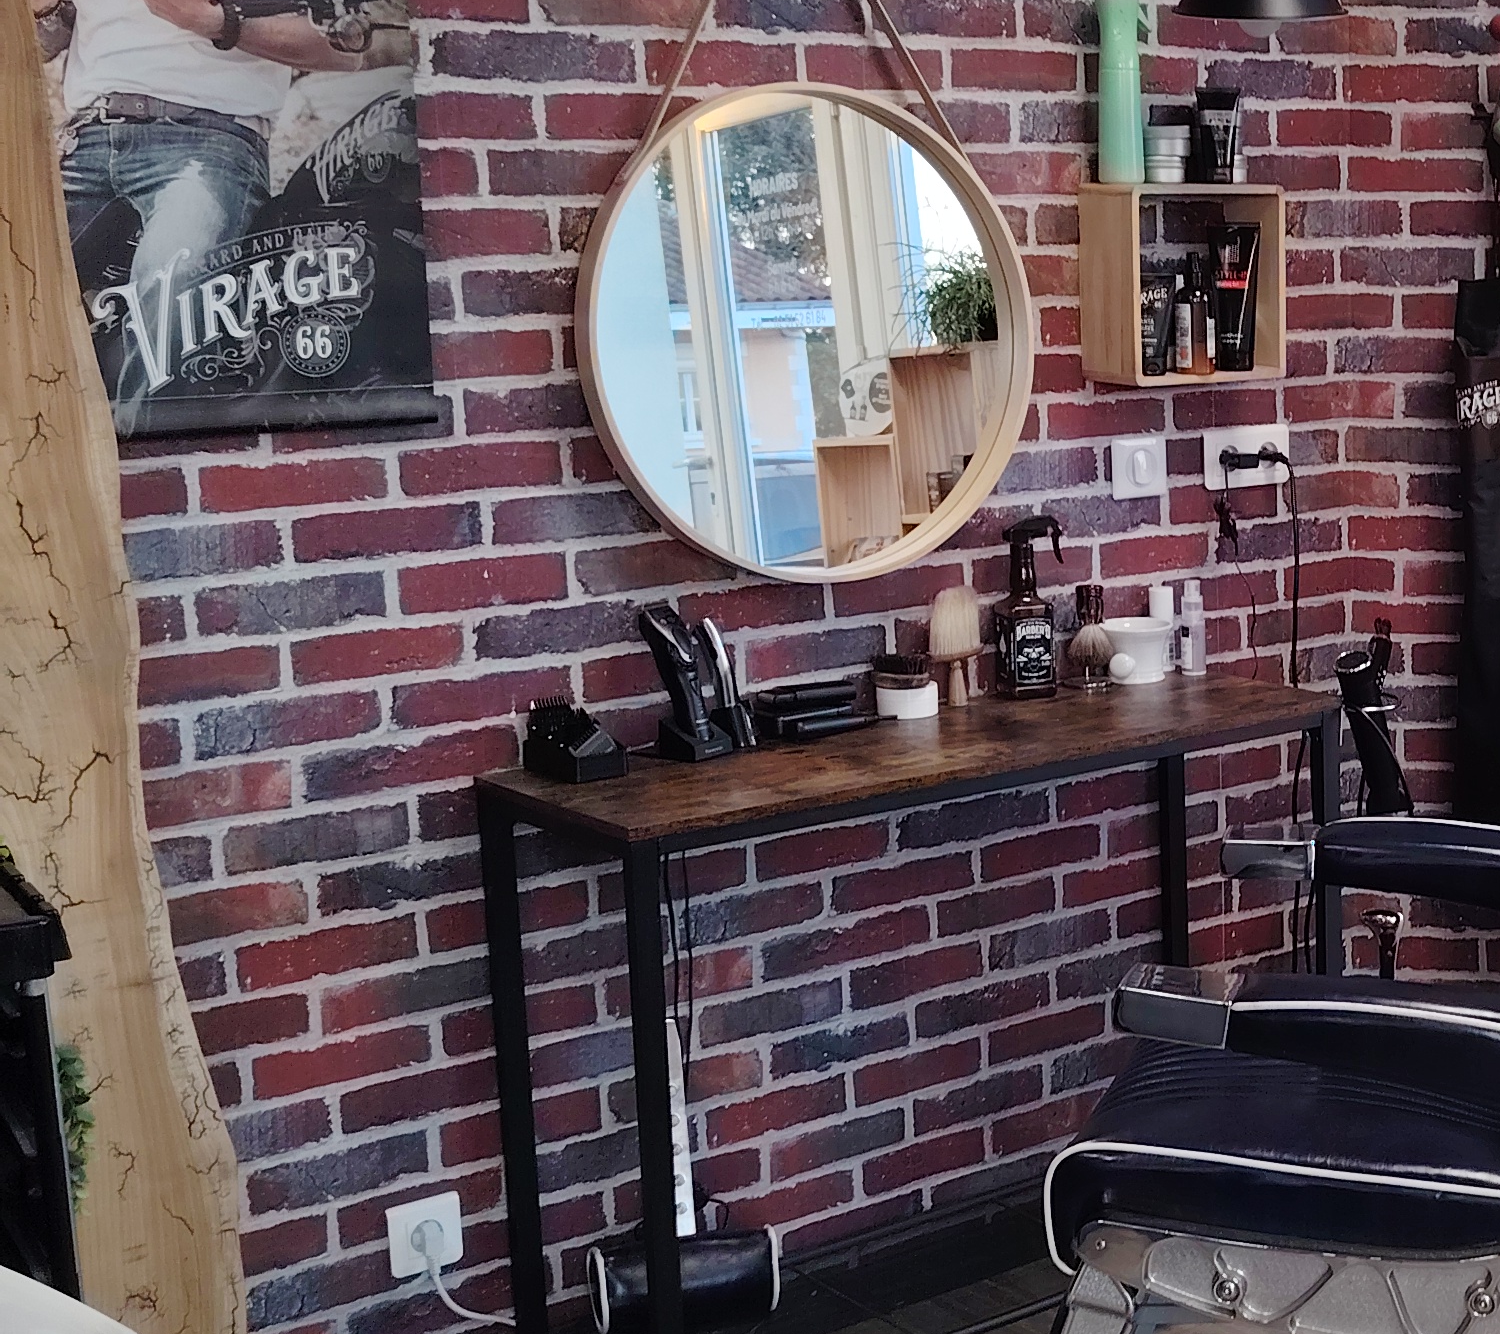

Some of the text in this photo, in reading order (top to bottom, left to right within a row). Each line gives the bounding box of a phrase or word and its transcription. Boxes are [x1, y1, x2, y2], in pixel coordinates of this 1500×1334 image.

[252, 234, 284, 255] AND
[1140, 287, 1168, 305] RAGE
[92, 246, 362, 396] VIRAGE
[296, 324, 333, 361] 66
[1486, 411, 1498, 424] 66
